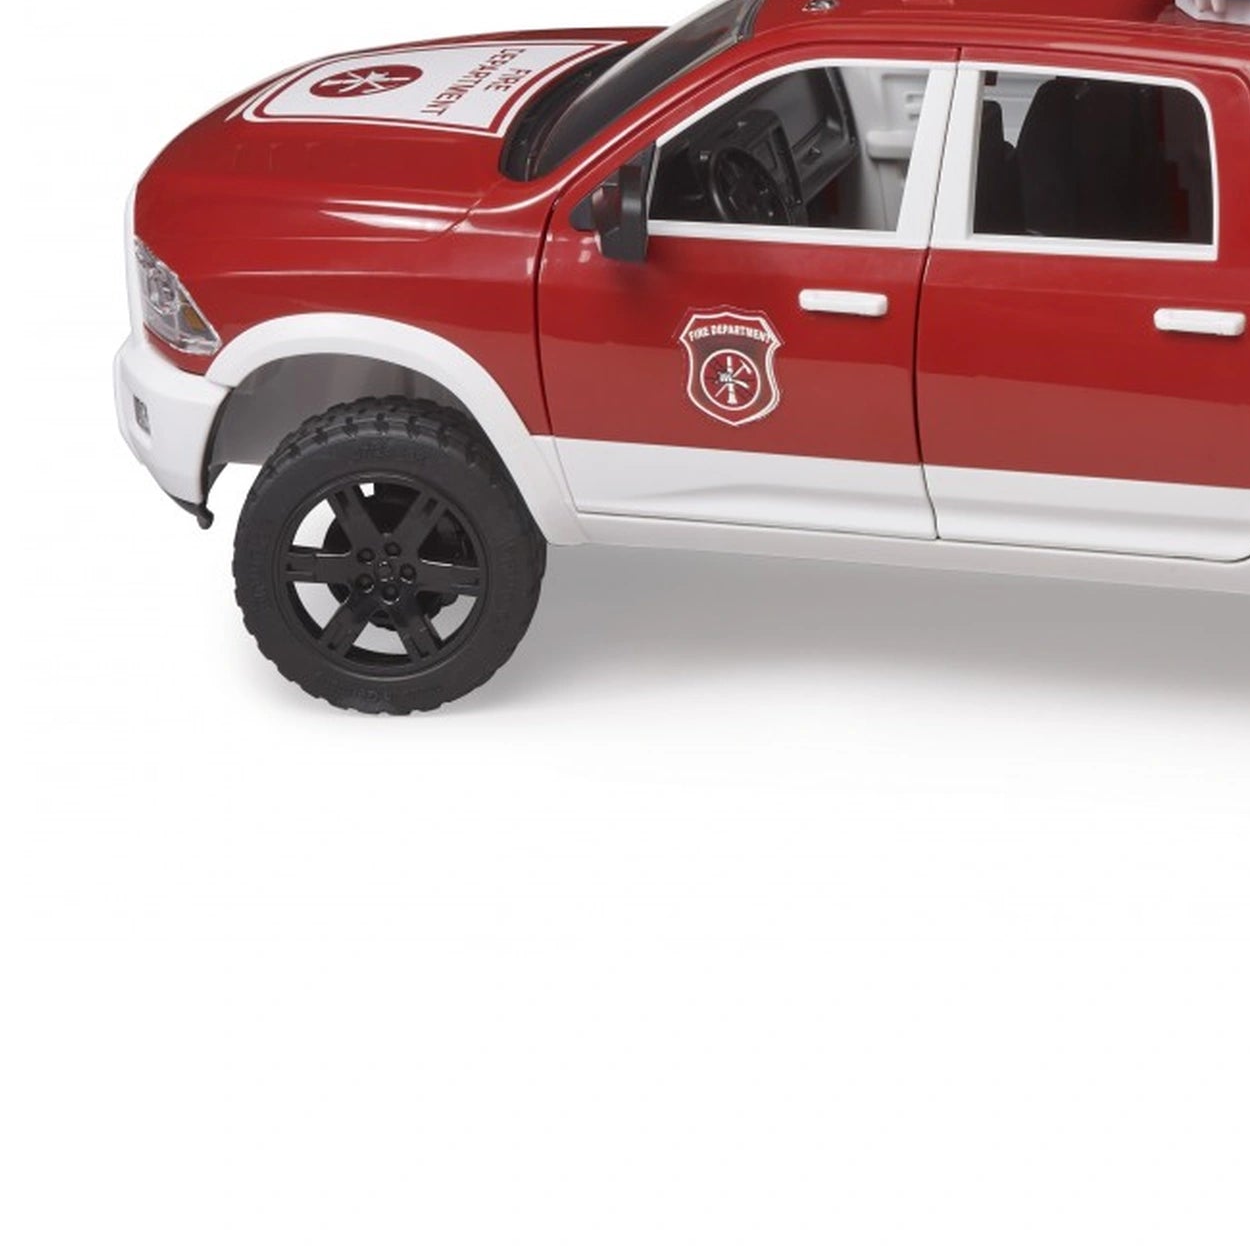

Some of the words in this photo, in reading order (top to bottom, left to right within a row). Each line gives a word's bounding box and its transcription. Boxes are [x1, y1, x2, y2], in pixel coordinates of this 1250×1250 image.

[420, 48, 527, 117] DEPARTMENT
[483, 69, 532, 92] FIRE
[688, 327, 709, 342] FIRE
[710, 324, 771, 344] DEPARTMENT
